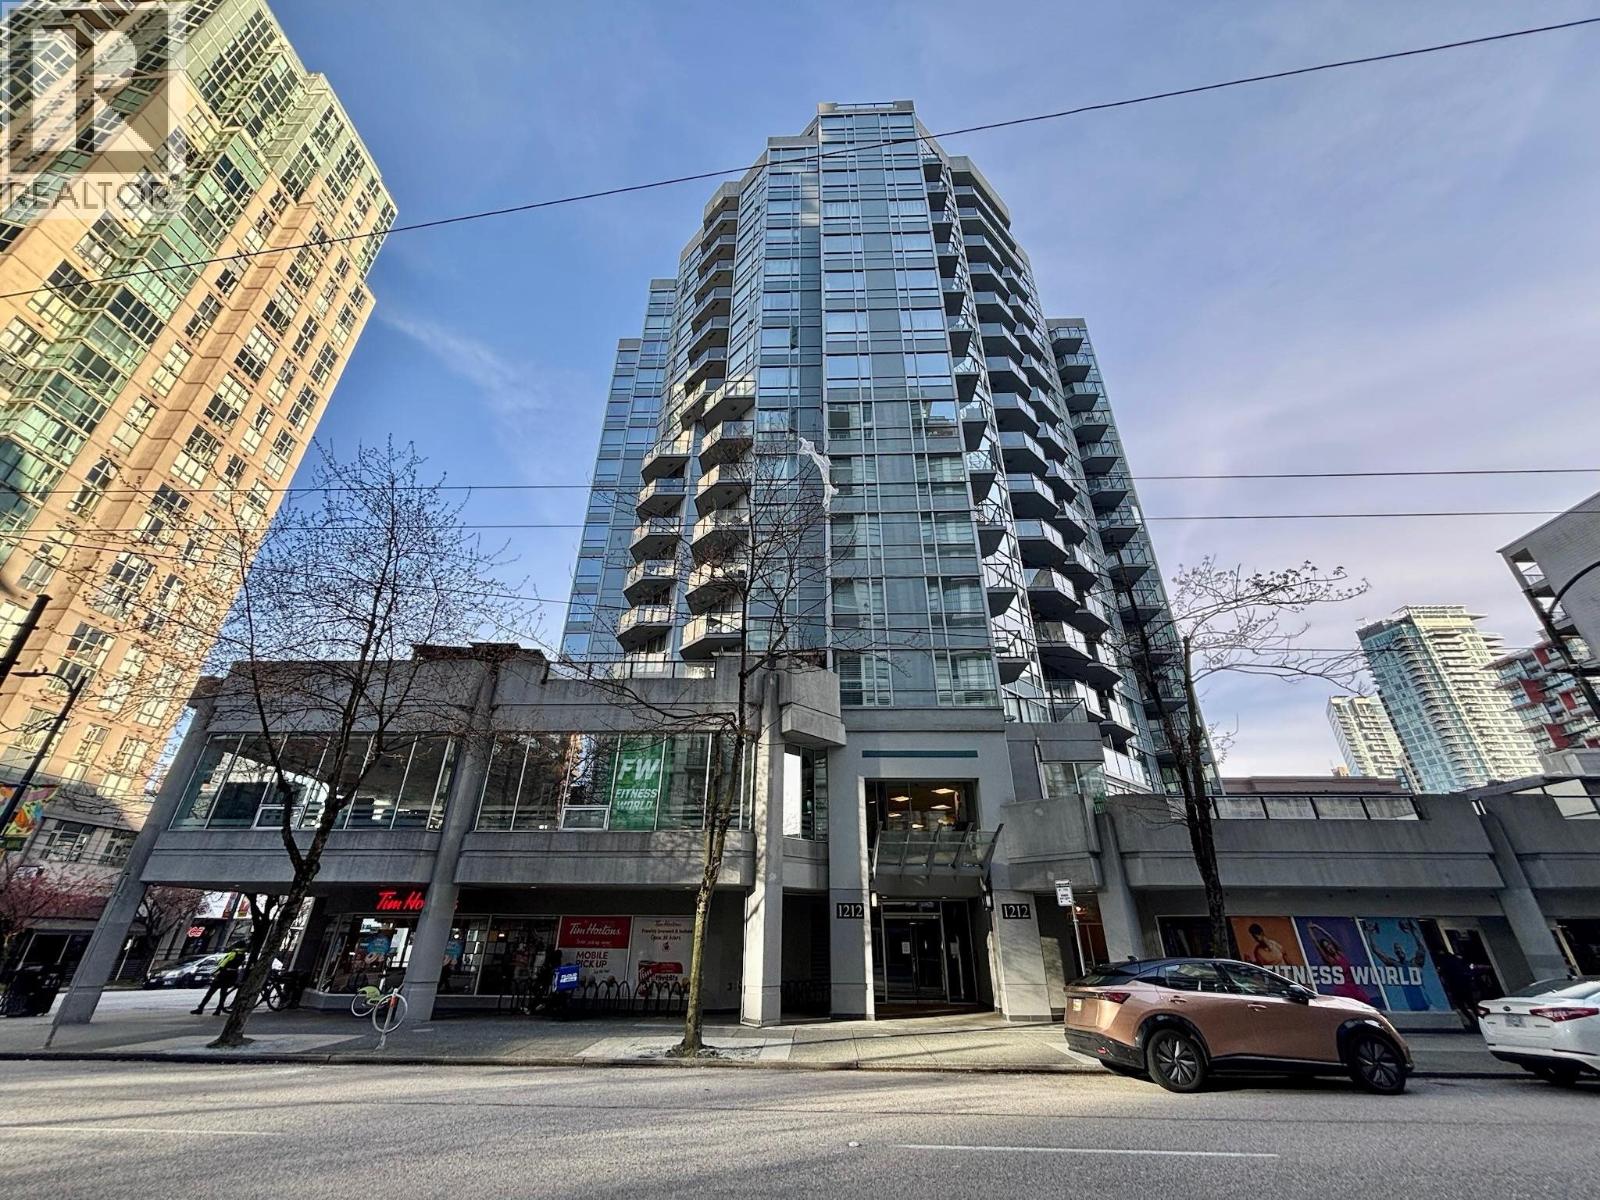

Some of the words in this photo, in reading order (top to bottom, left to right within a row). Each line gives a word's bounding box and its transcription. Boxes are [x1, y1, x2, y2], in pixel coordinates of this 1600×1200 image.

[617, 758, 661, 780] FW
[615, 788, 658, 799] FITNESS
[616, 800, 653, 810] WORLD
[376, 891, 402, 910] Tim
[838, 904, 863, 917] 1212
[1003, 905, 1030, 918] 1212
[570, 922, 585, 935] Tim
[586, 922, 621, 936] Hortons
[576, 951, 609, 960] MOBILE
[576, 960, 594, 968] PICK
[595, 960, 608, 968] UP
[1349, 966, 1422, 986] WORLD
